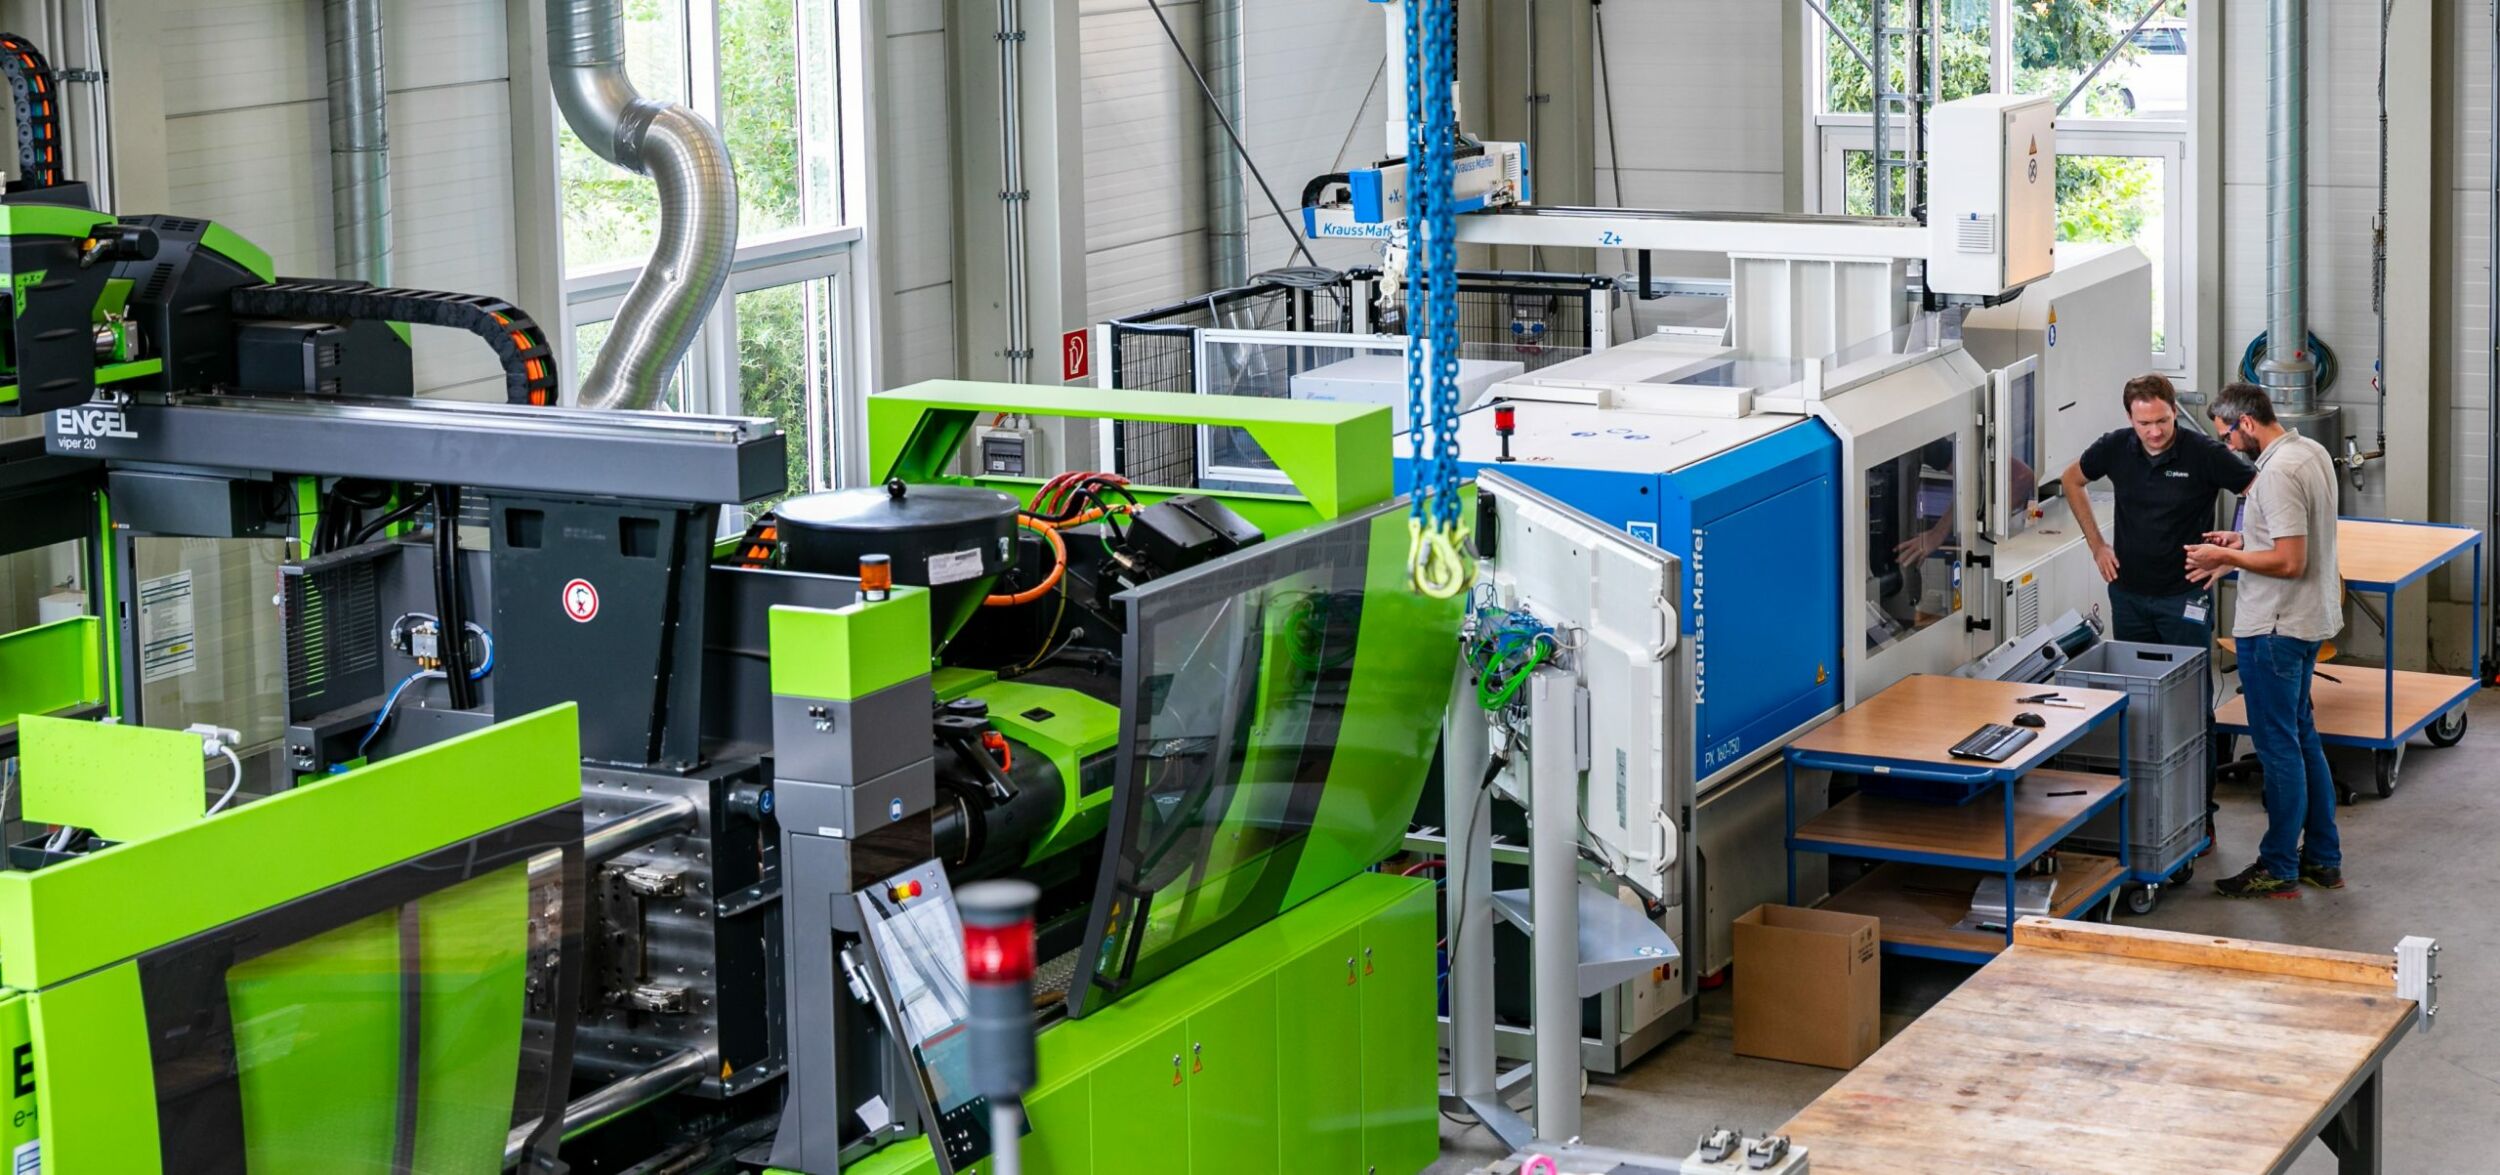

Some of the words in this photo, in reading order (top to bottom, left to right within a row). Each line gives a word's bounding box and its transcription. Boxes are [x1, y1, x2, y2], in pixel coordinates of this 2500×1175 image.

[1323, 221, 1364, 236] Krauss
[1365, 224, 1392, 237] Maff
[56, 408, 138, 439] ENGEL
[58, 437, 81, 450] viper
[83, 438, 96, 450] 20
[1692, 527, 1704, 610] Maffei
[1694, 613, 1705, 705] Krauss
[1705, 749, 1715, 769] PX
[1717, 736, 1740, 762] 160-750
[13, 1042, 36, 1099] E
